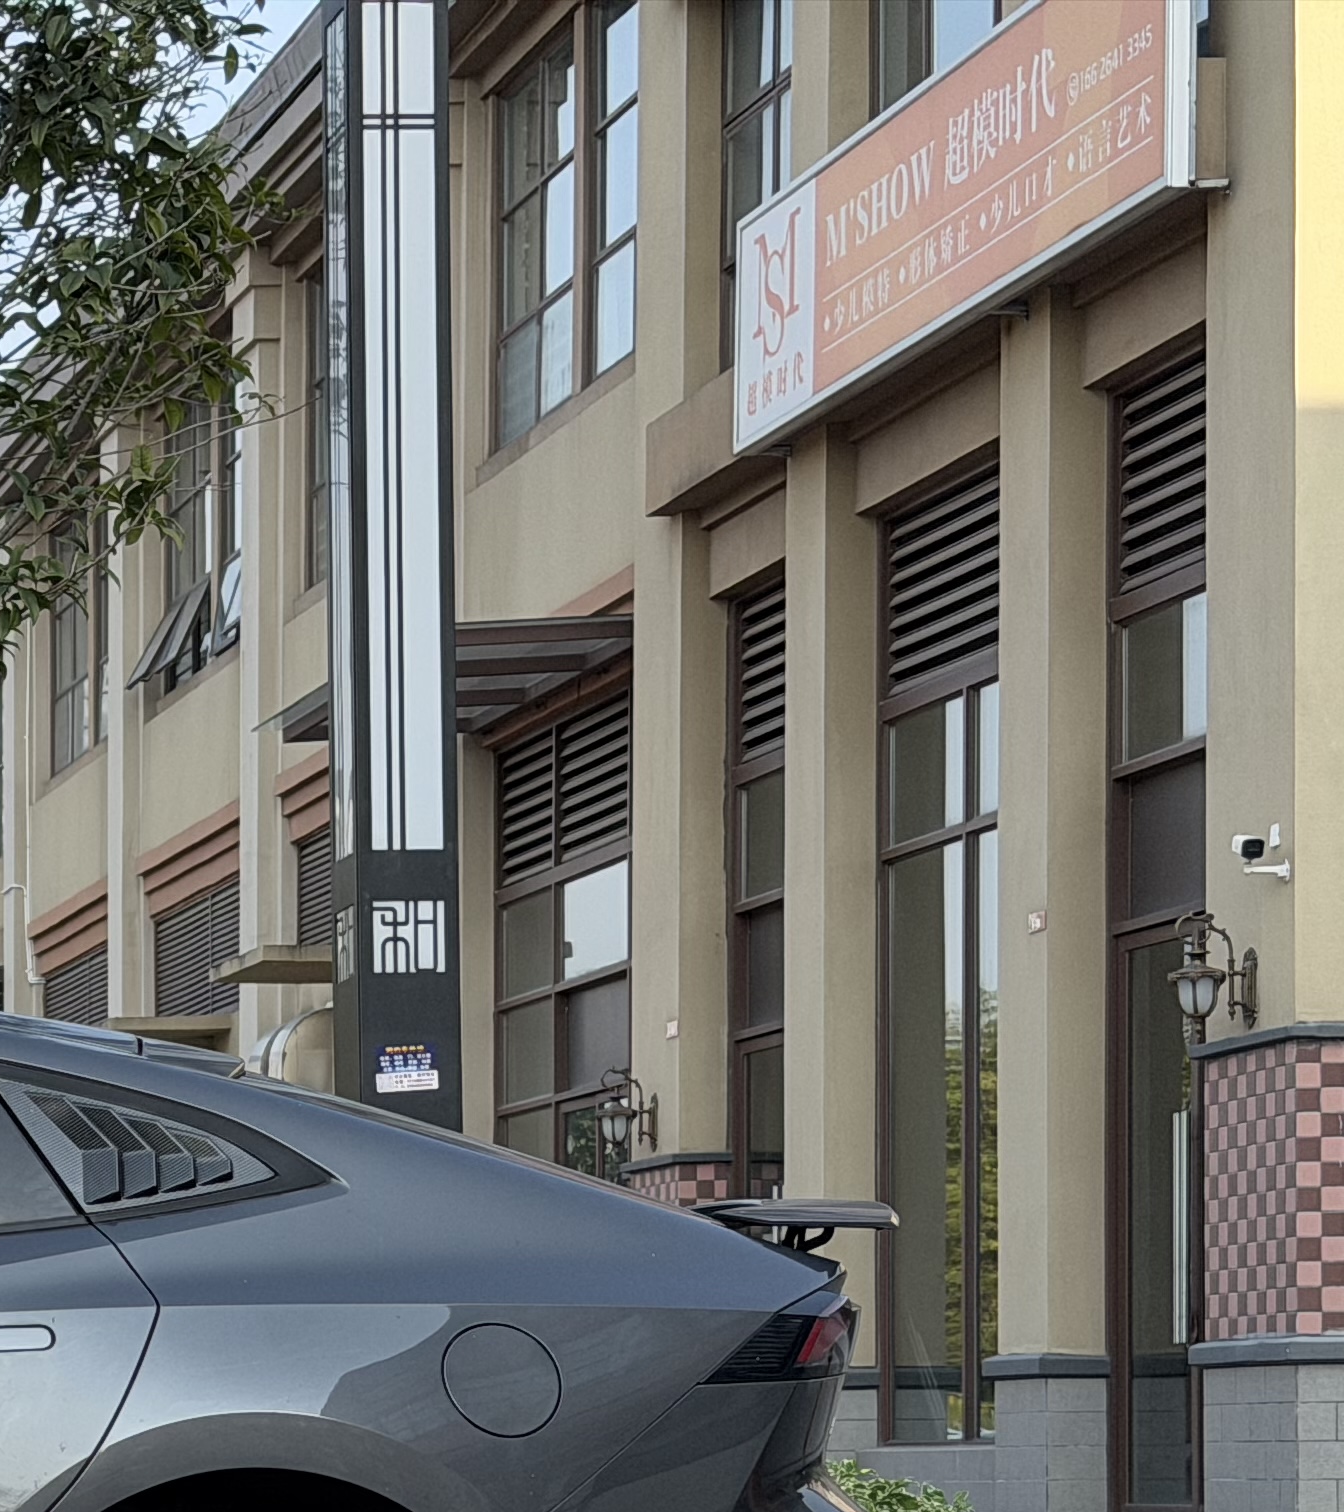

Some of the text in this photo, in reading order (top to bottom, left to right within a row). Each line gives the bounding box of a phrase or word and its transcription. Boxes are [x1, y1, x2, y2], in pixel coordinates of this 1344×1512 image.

[825, 48, 1056, 267] M'SHOW 超模时代
[1080, 62, 1097, 93] 166
[1127, 24, 1152, 62] 3345
[834, 92, 1152, 335] 少儿模特 形体矫正 少儿口才 语言艺术
